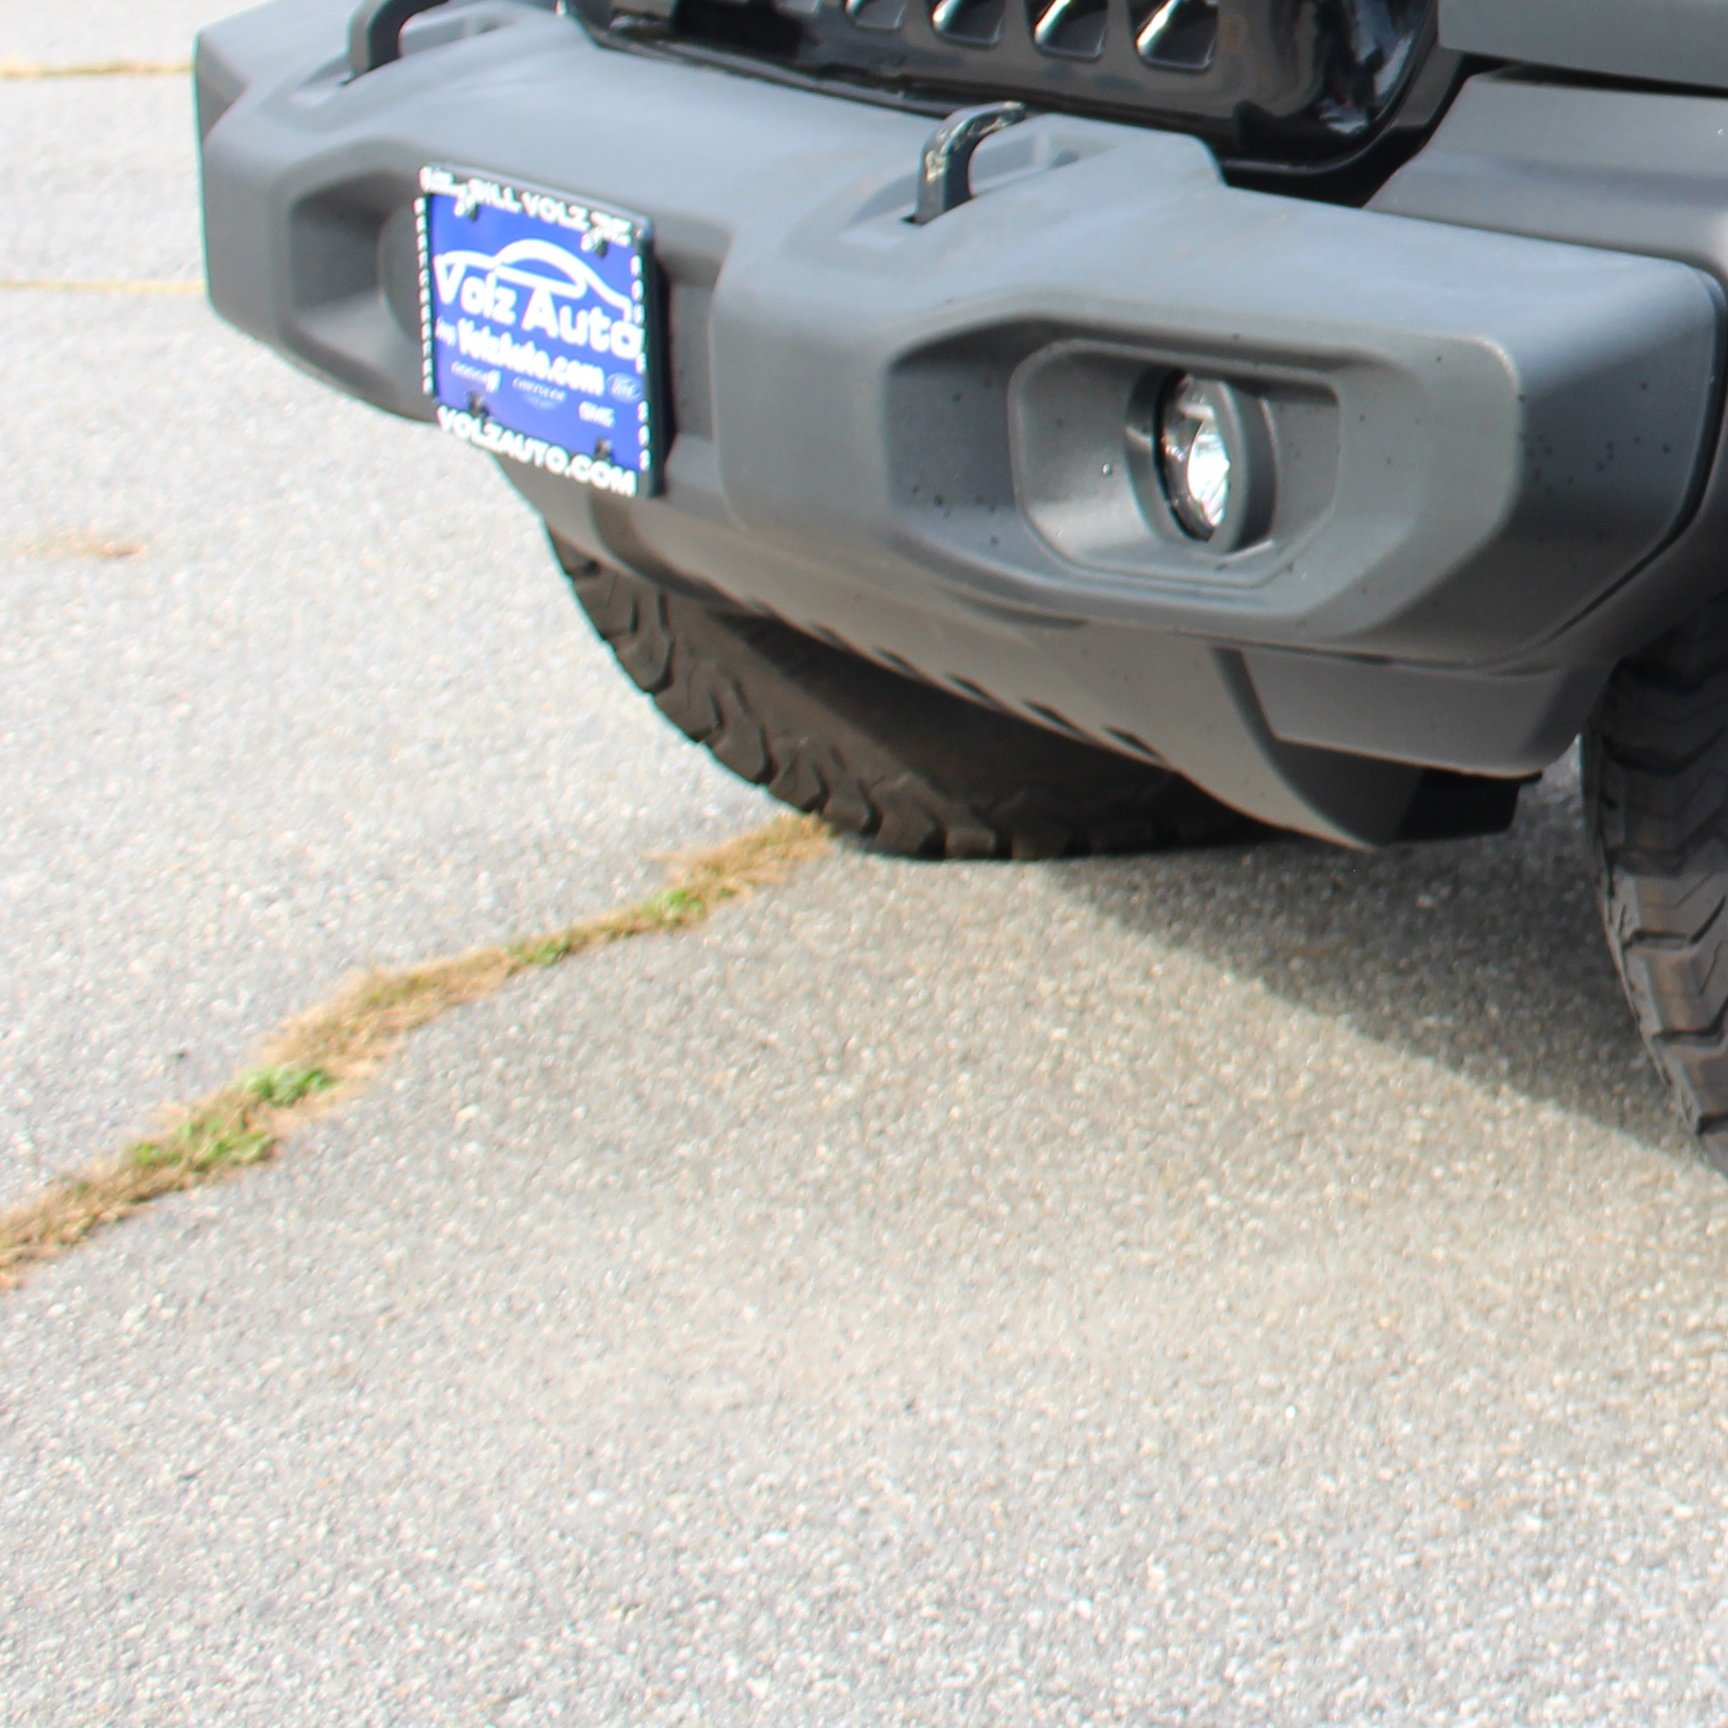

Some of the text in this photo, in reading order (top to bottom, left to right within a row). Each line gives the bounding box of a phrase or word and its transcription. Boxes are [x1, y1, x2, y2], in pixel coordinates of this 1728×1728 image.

[522, 190, 591, 230] VOLZ
[433, 253, 517, 326] Volz
[521, 285, 646, 360] Auto
[436, 405, 638, 498] VOLZAUTO.COM
